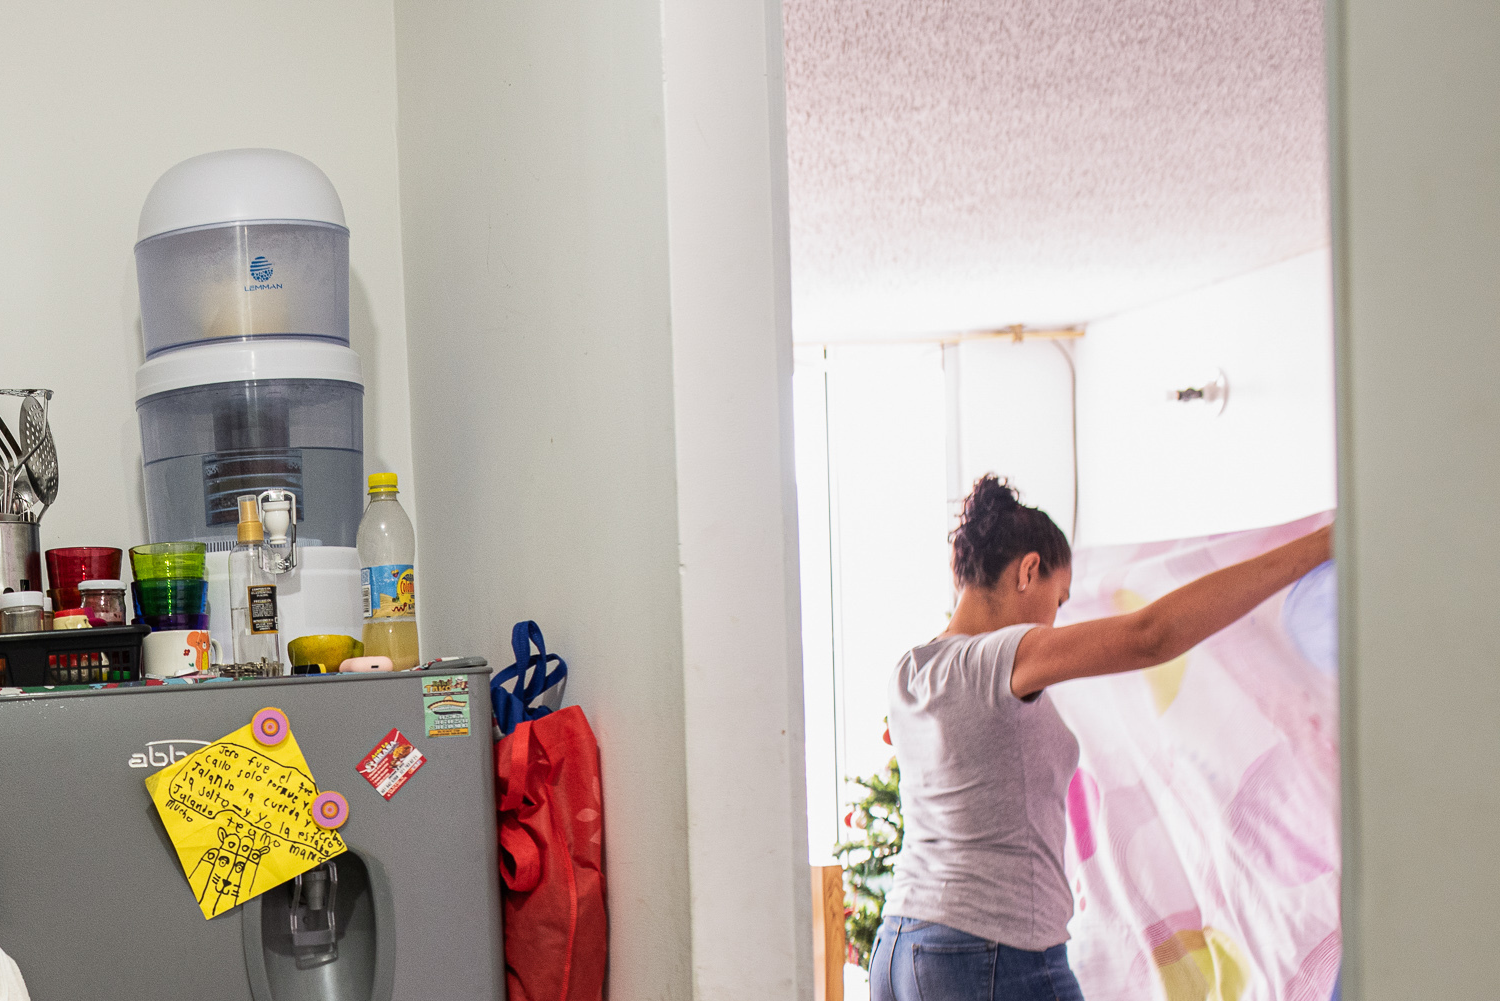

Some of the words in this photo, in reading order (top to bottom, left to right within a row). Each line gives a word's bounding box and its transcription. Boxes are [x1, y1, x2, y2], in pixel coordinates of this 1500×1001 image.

[244, 283, 283, 291] LEMMAN
[128, 744, 188, 768] abb
[373, 741, 397, 764] BRASA
[219, 746, 239, 759] Jero
[248, 756, 269, 774] fue
[279, 771, 292, 784] el
[237, 769, 262, 782] solo
[173, 783, 213, 816] Jalando
[192, 761, 234, 791] Jalando
[243, 788, 254, 803] la
[264, 798, 299, 821] cuerda
[227, 816, 244, 834] te
[279, 821, 290, 838] la
